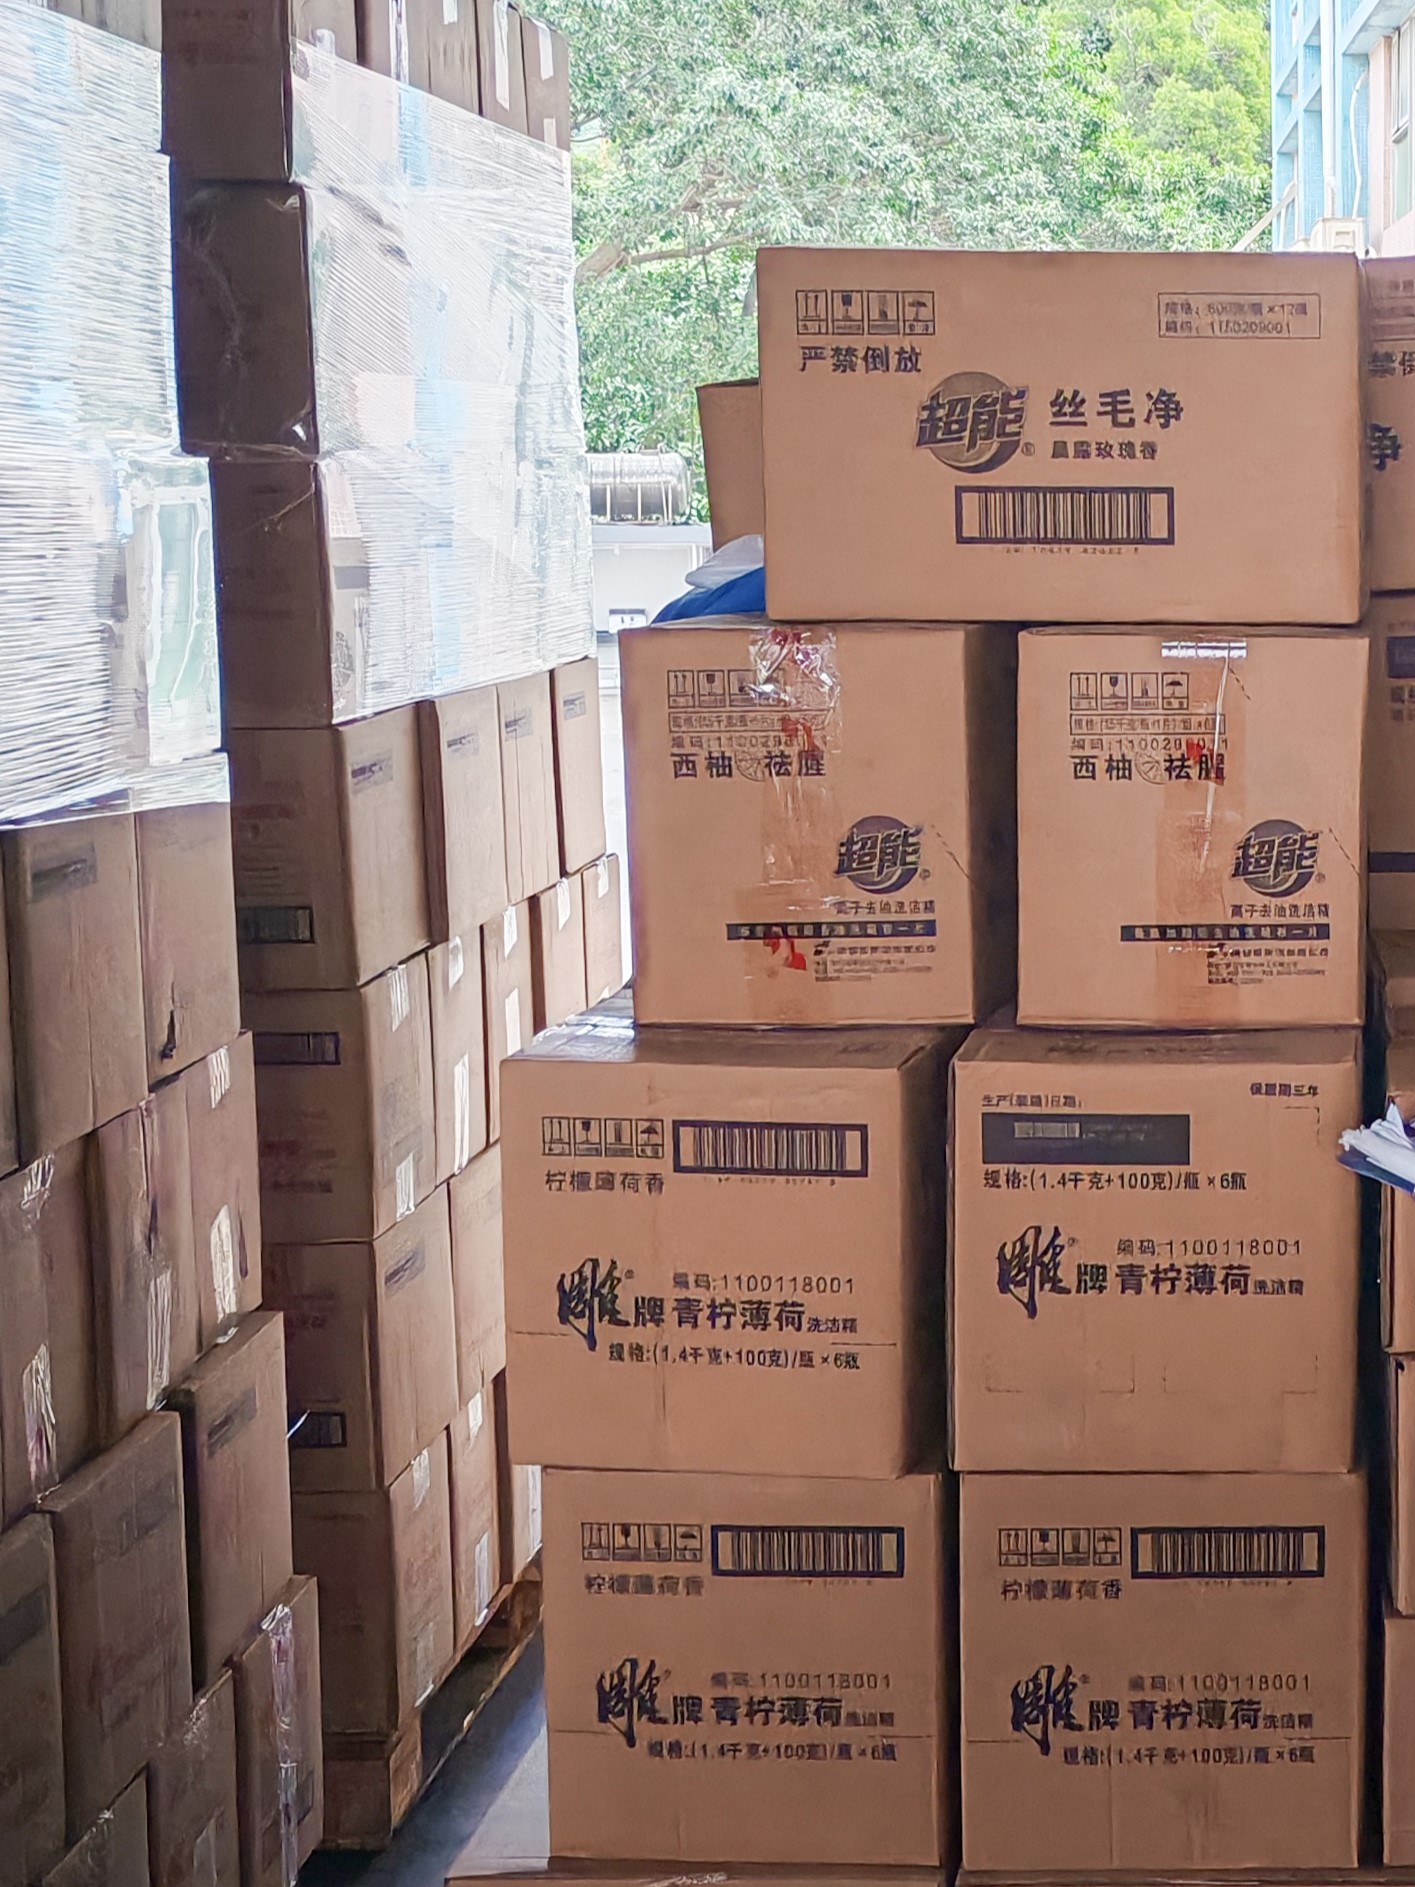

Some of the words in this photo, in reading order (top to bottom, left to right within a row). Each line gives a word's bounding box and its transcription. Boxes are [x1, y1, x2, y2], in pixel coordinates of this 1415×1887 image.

[799, 344, 922, 374] 严禁倒放
[915, 385, 1031, 455] 超能
[1049, 387, 1184, 430] 丝毛净
[670, 752, 734, 779] 西柚
[1070, 752, 1133, 782] 西柚
[833, 824, 926, 879] 超能
[1229, 829, 1324, 884] 超能
